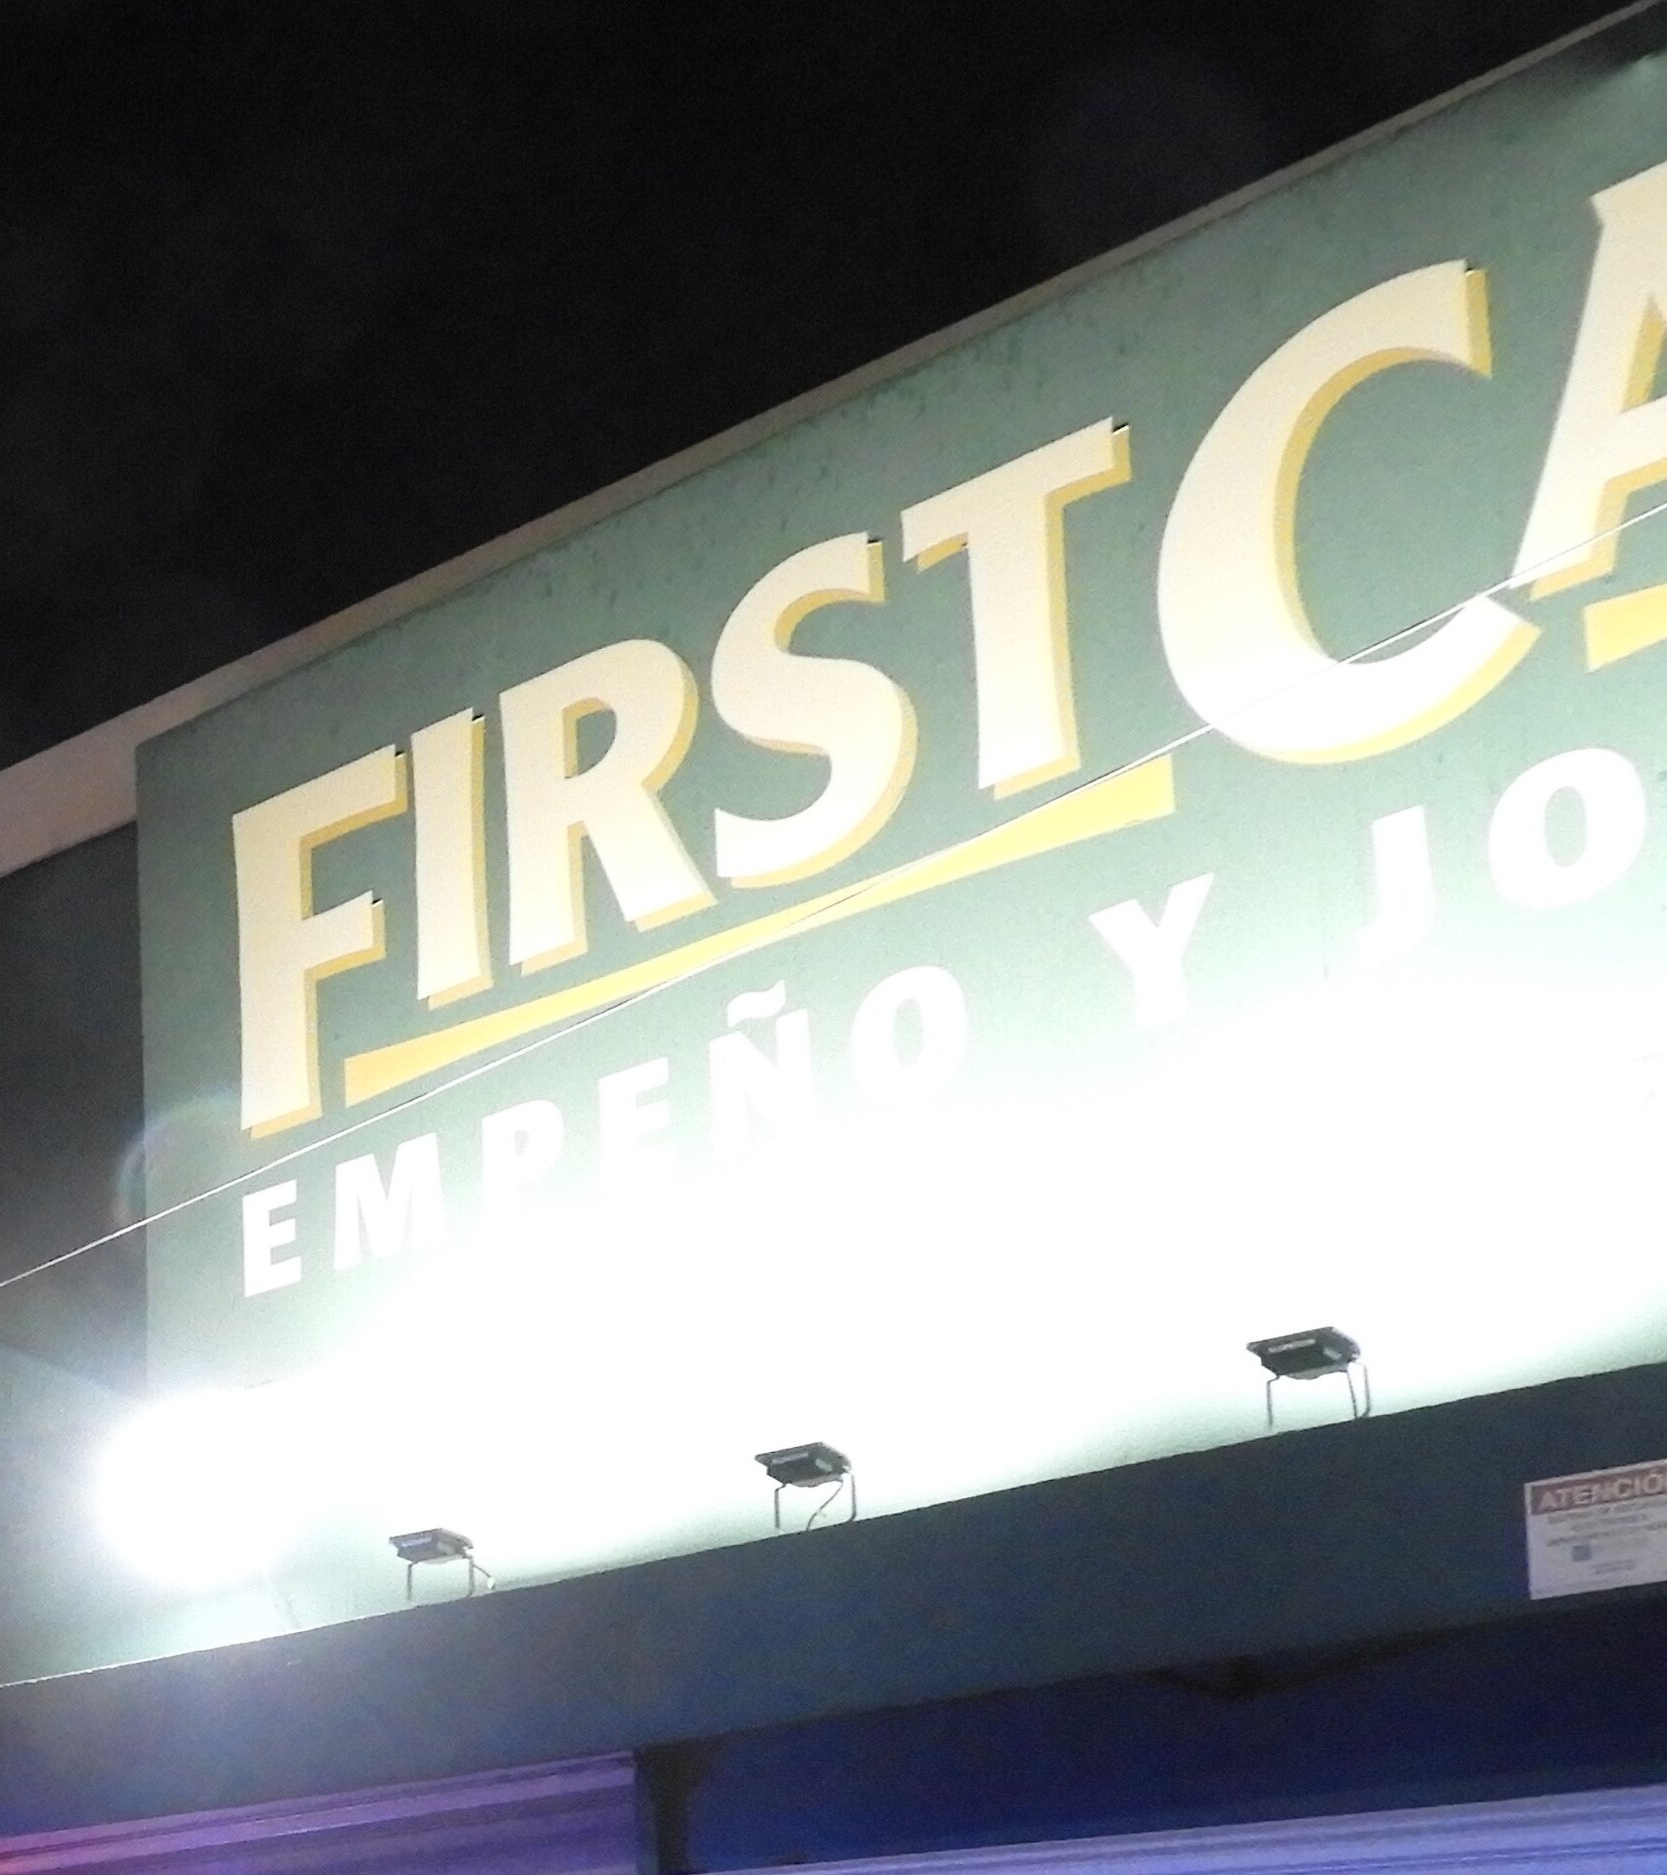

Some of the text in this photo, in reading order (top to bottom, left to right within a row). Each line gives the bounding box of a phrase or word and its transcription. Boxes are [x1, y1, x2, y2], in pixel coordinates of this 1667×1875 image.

[241, 747, 1646, 1297] EMPEÑO Y JO
